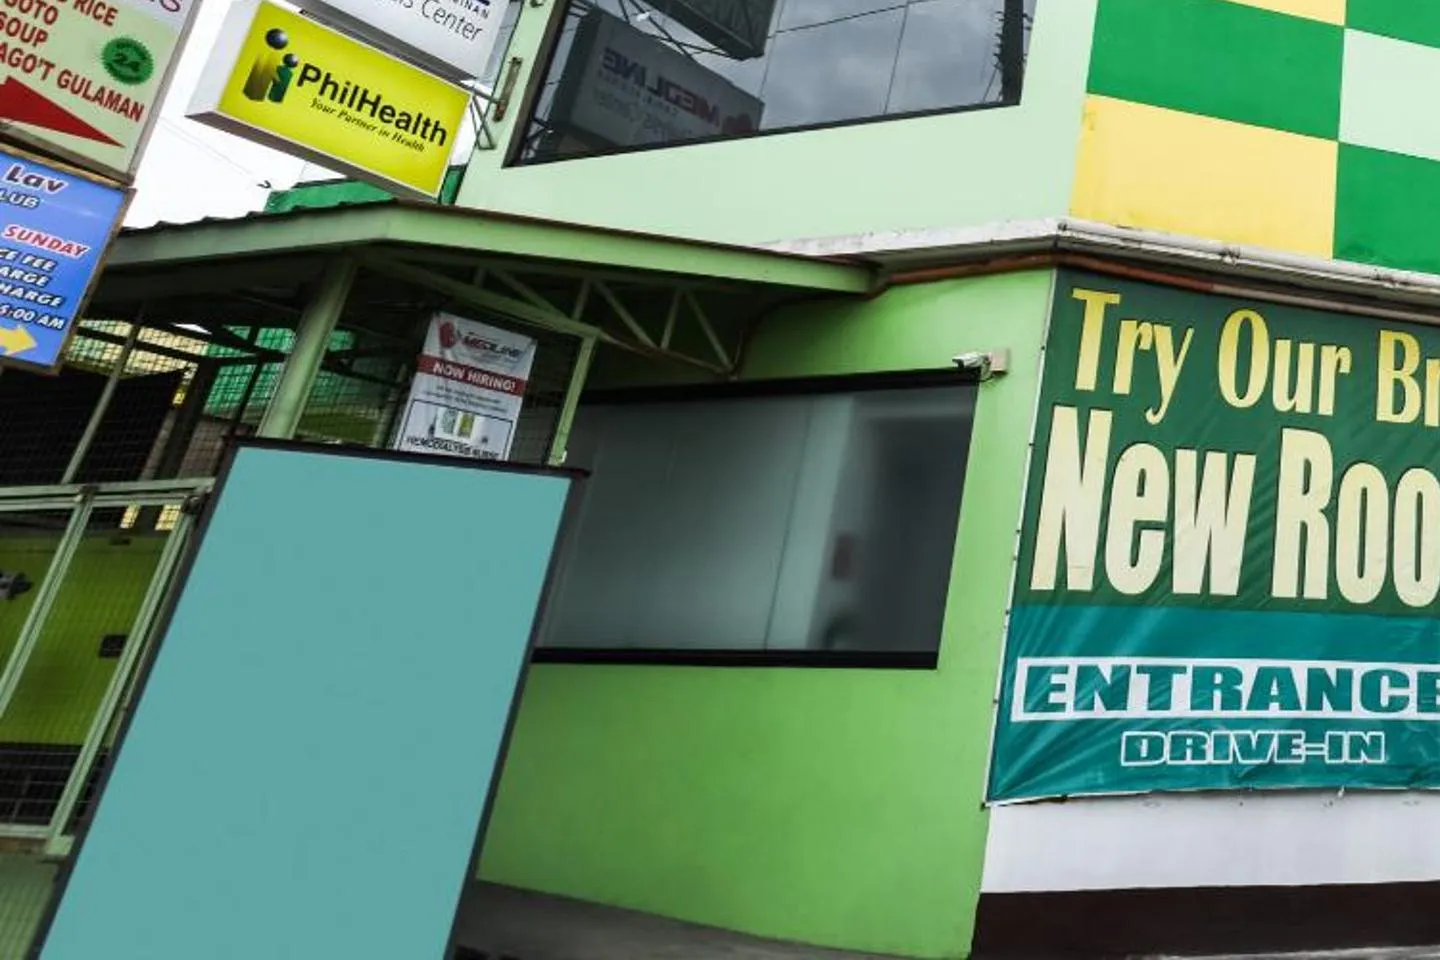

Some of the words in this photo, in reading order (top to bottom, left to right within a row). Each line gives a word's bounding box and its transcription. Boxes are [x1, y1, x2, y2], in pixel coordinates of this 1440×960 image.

[57, 69, 144, 122] GULAMAN
[297, 63, 448, 147] PhilHealth
[337, 110, 378, 132] Partner
[391, 131, 425, 152] Health
[5, 226, 88, 256] SUNDAY
[37, 315, 65, 329] AM
[432, 362, 465, 379] NOW
[467, 369, 516, 391] HIRING!
[1072, 288, 1195, 425] Try
[1218, 309, 1352, 416] Our
[1029, 405, 1257, 596] New
[1121, 730, 1387, 768] DRIVE-IN
